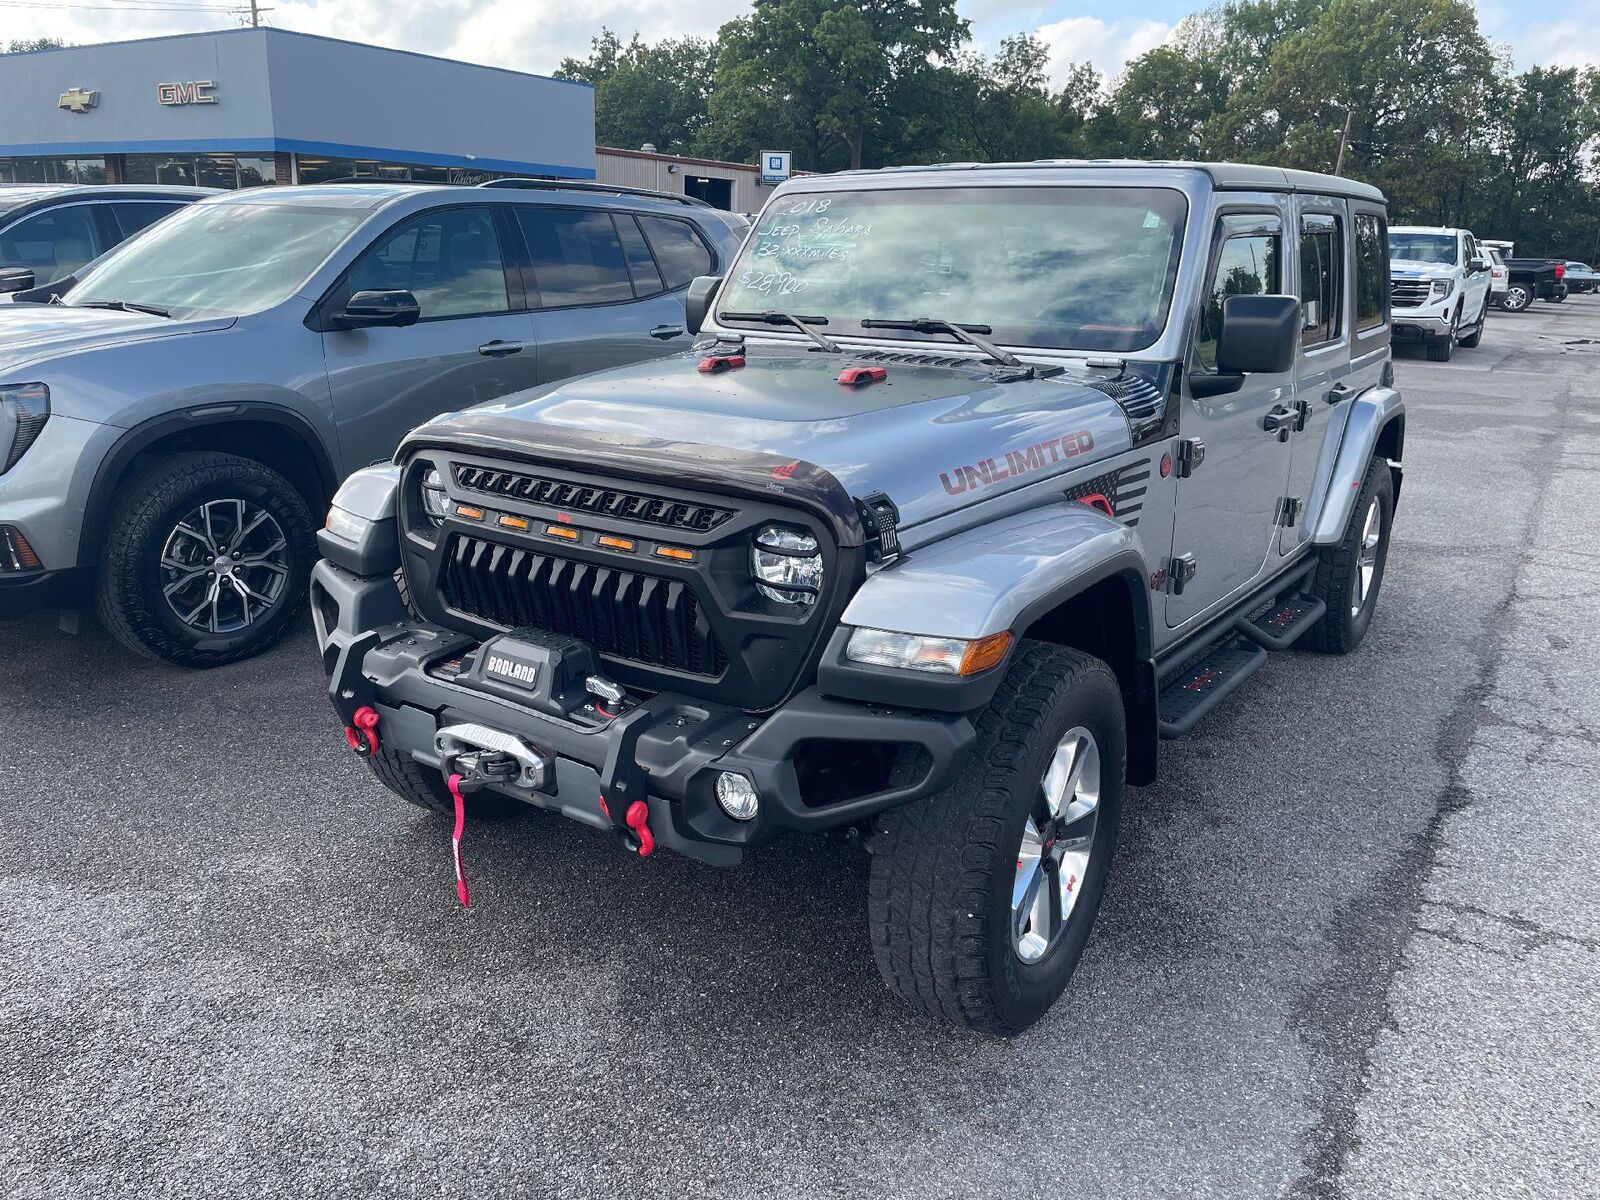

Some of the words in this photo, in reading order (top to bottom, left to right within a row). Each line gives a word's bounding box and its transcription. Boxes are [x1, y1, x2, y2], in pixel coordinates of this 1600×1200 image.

[157, 80, 216, 105] GMC
[938, 430, 1096, 496] UNLIMITED
[766, 481, 785, 495] Jeep
[487, 656, 536, 683] BADLAND
